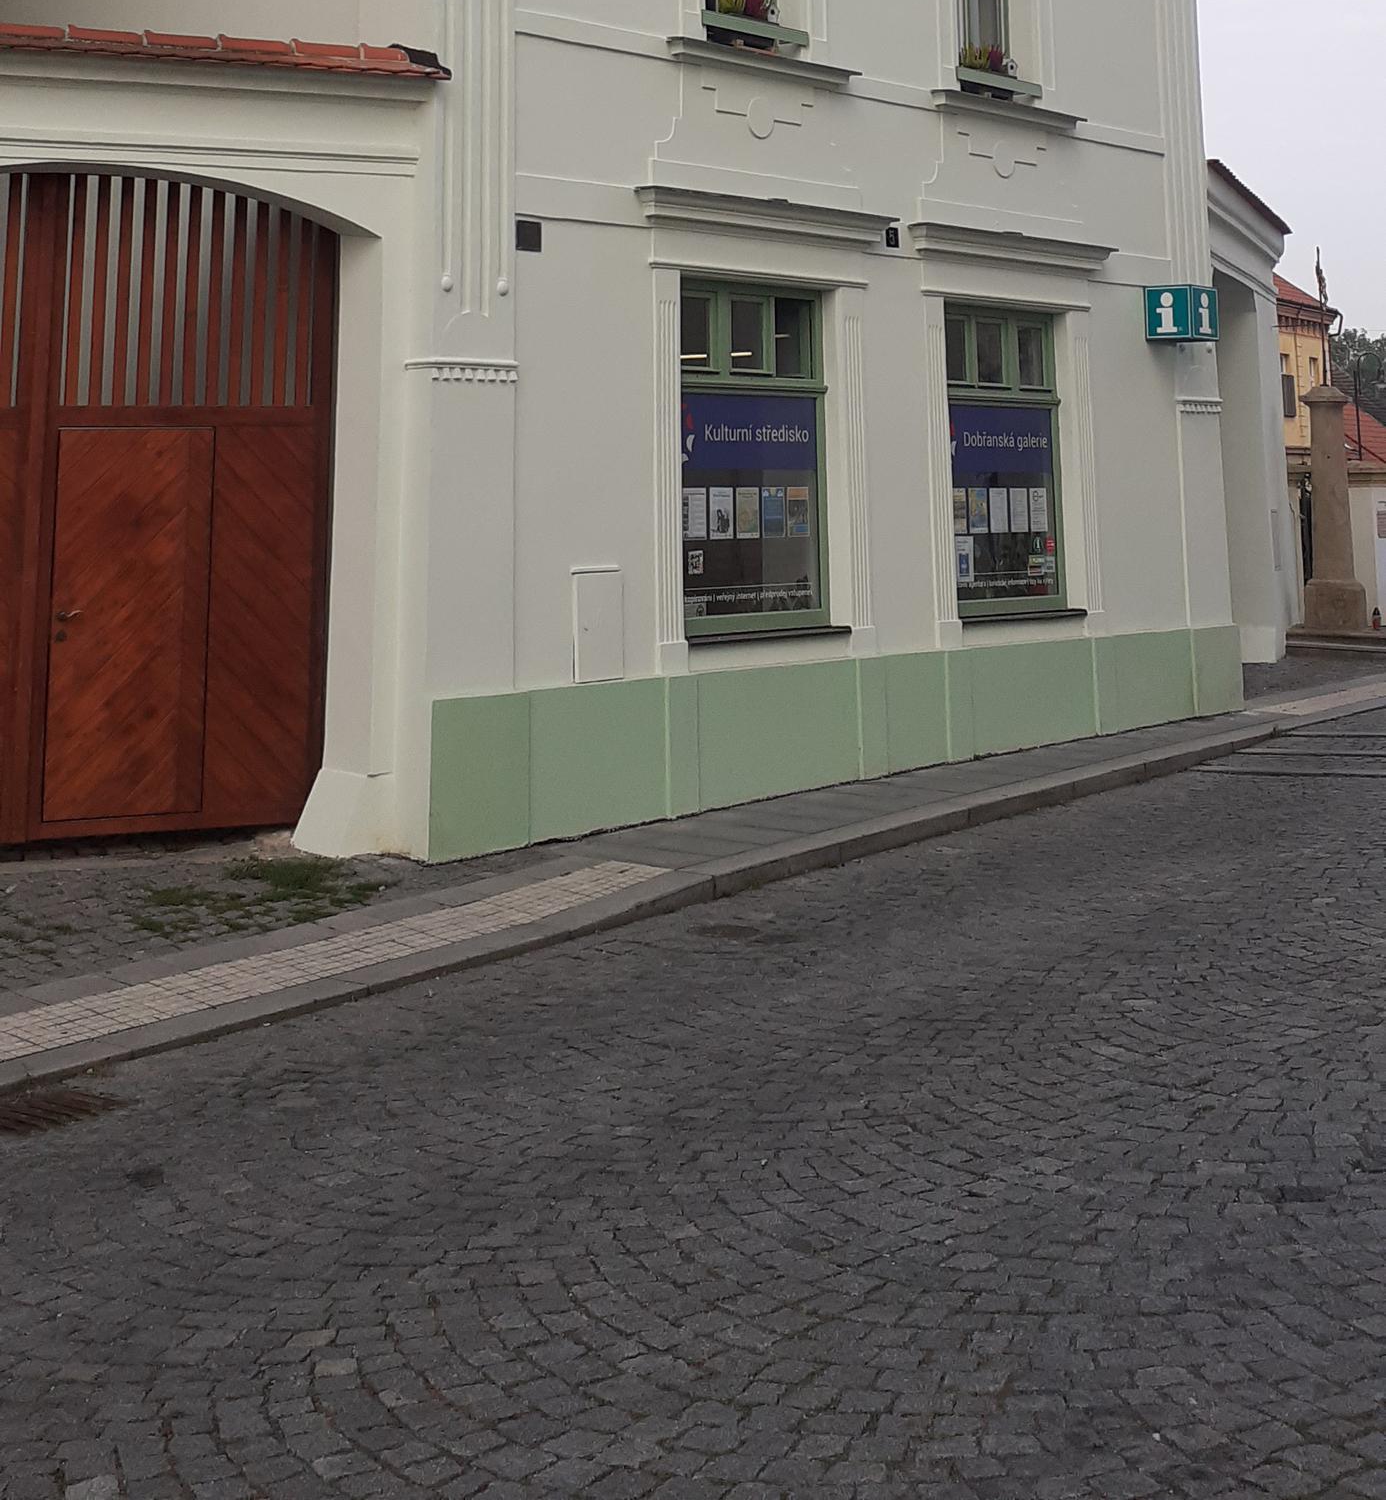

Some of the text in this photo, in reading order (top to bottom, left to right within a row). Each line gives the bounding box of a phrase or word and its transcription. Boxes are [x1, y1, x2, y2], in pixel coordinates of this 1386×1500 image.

[704, 423, 809, 443] Kulturní středisko
[963, 430, 1048, 452] Dobřanská galerie
